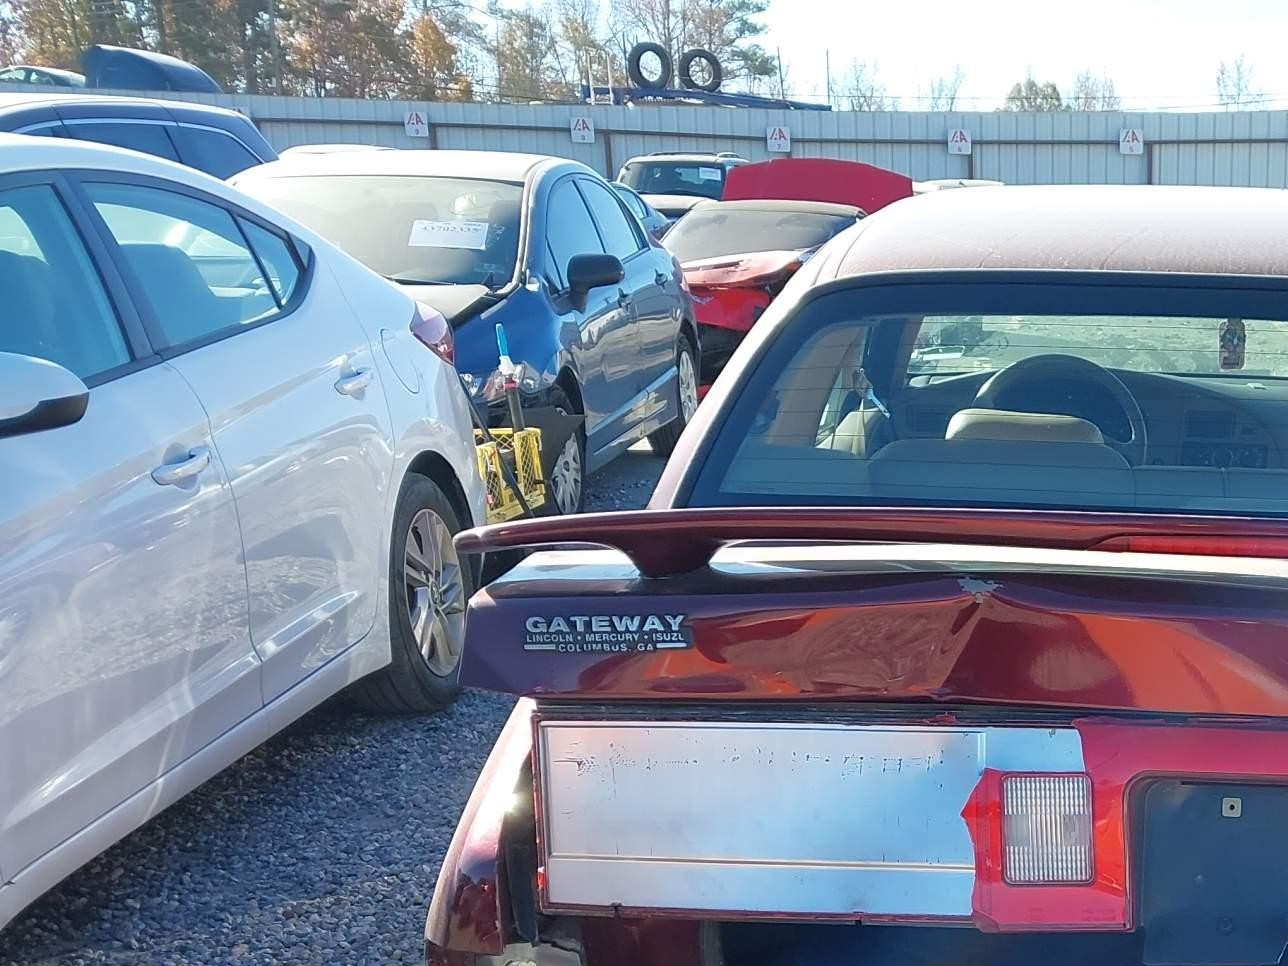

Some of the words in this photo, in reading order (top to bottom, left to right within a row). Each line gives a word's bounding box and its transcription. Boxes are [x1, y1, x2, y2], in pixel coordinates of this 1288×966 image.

[526, 615, 685, 632] GATEWAY
[526, 634, 573, 643] LINCOLN
[586, 633, 640, 642] MERCURY
[637, 643, 654, 651] GA
